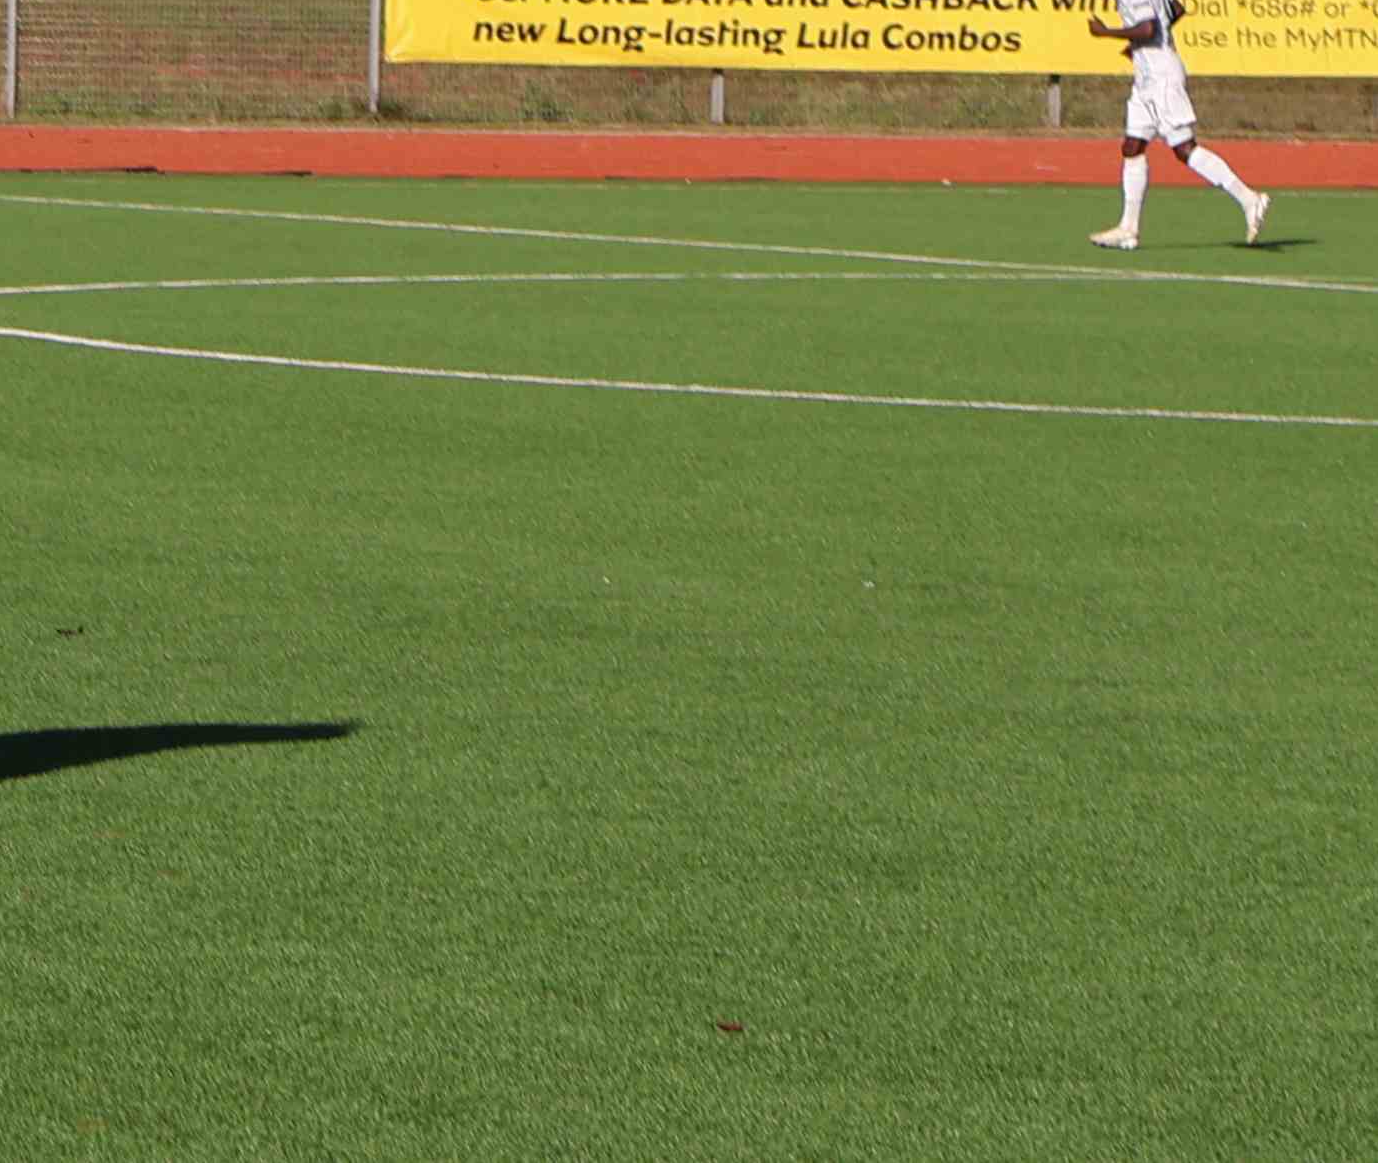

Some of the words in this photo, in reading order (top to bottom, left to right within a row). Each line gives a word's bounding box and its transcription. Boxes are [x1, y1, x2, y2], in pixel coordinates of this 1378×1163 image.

[1324, 2, 1351, 19] or
[473, 21, 545, 42] new
[556, 17, 786, 55] Long-lasting
[797, 22, 870, 50] Lula
[882, 23, 1022, 53] Combos
[1183, 30, 1229, 48] use
[1237, 27, 1278, 49] the
[1286, 27, 1378, 55] MyMTN
